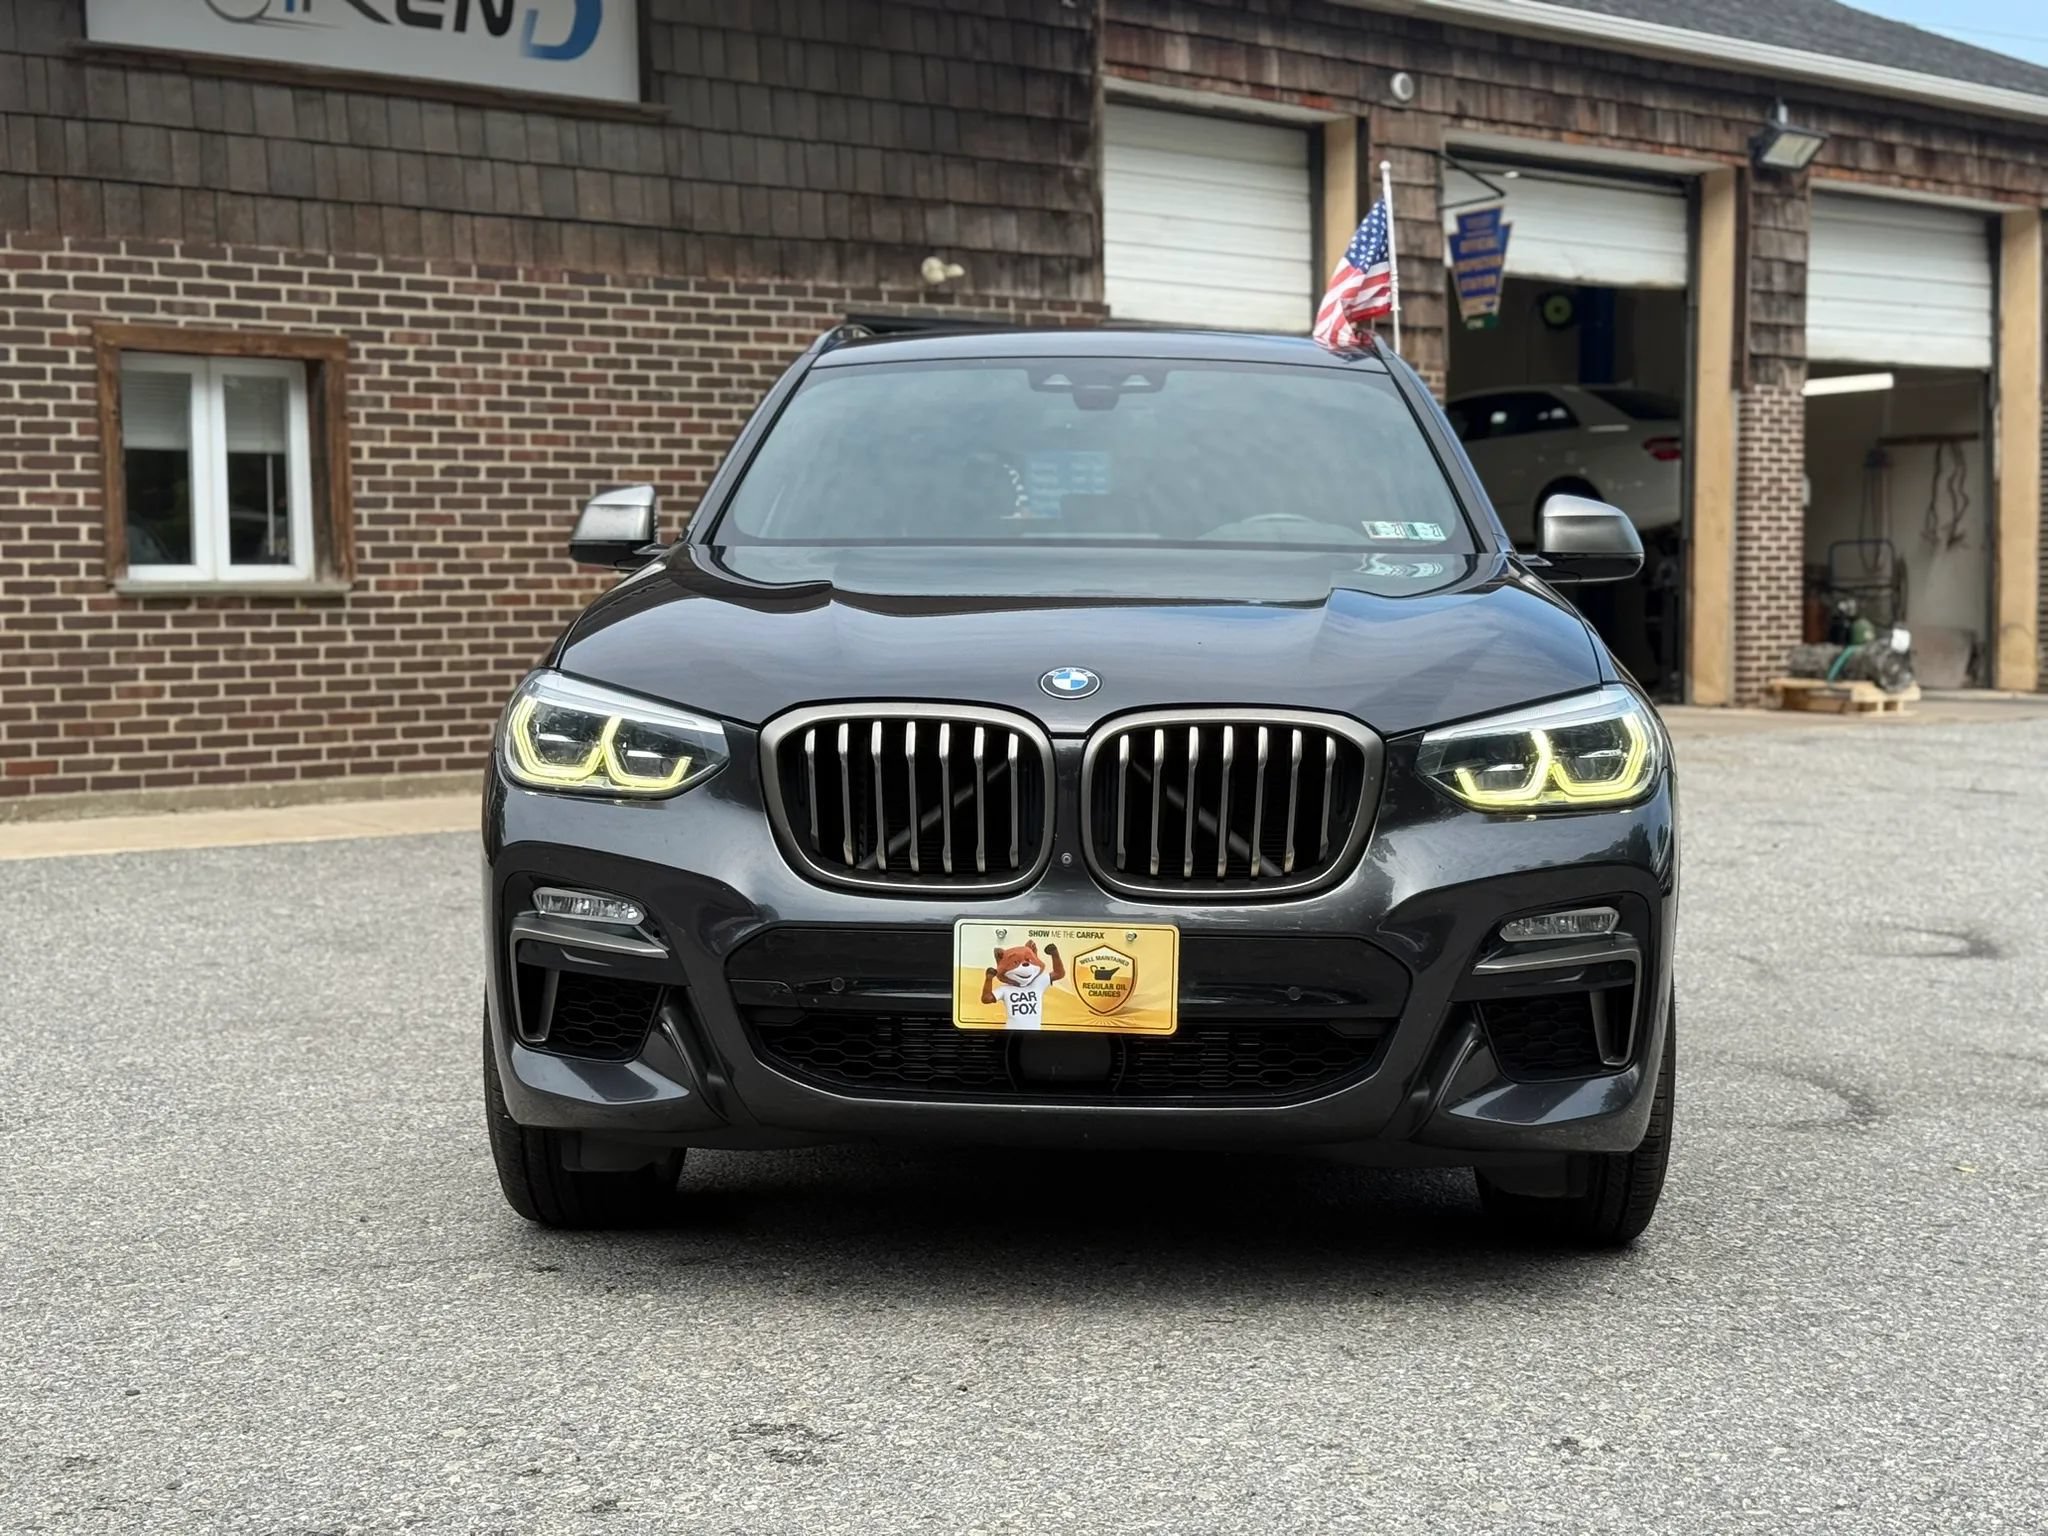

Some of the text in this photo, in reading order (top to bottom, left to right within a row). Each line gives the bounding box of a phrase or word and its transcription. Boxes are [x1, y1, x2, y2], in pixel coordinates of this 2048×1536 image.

[1028, 930, 1105, 939] SHOW ME THE CARFAX
[1082, 982, 1114, 990] REGULAR
[1010, 991, 1038, 1003] CAR
[1088, 990, 1121, 998] CHANGES
[1011, 1003, 1038, 1016] FOX
